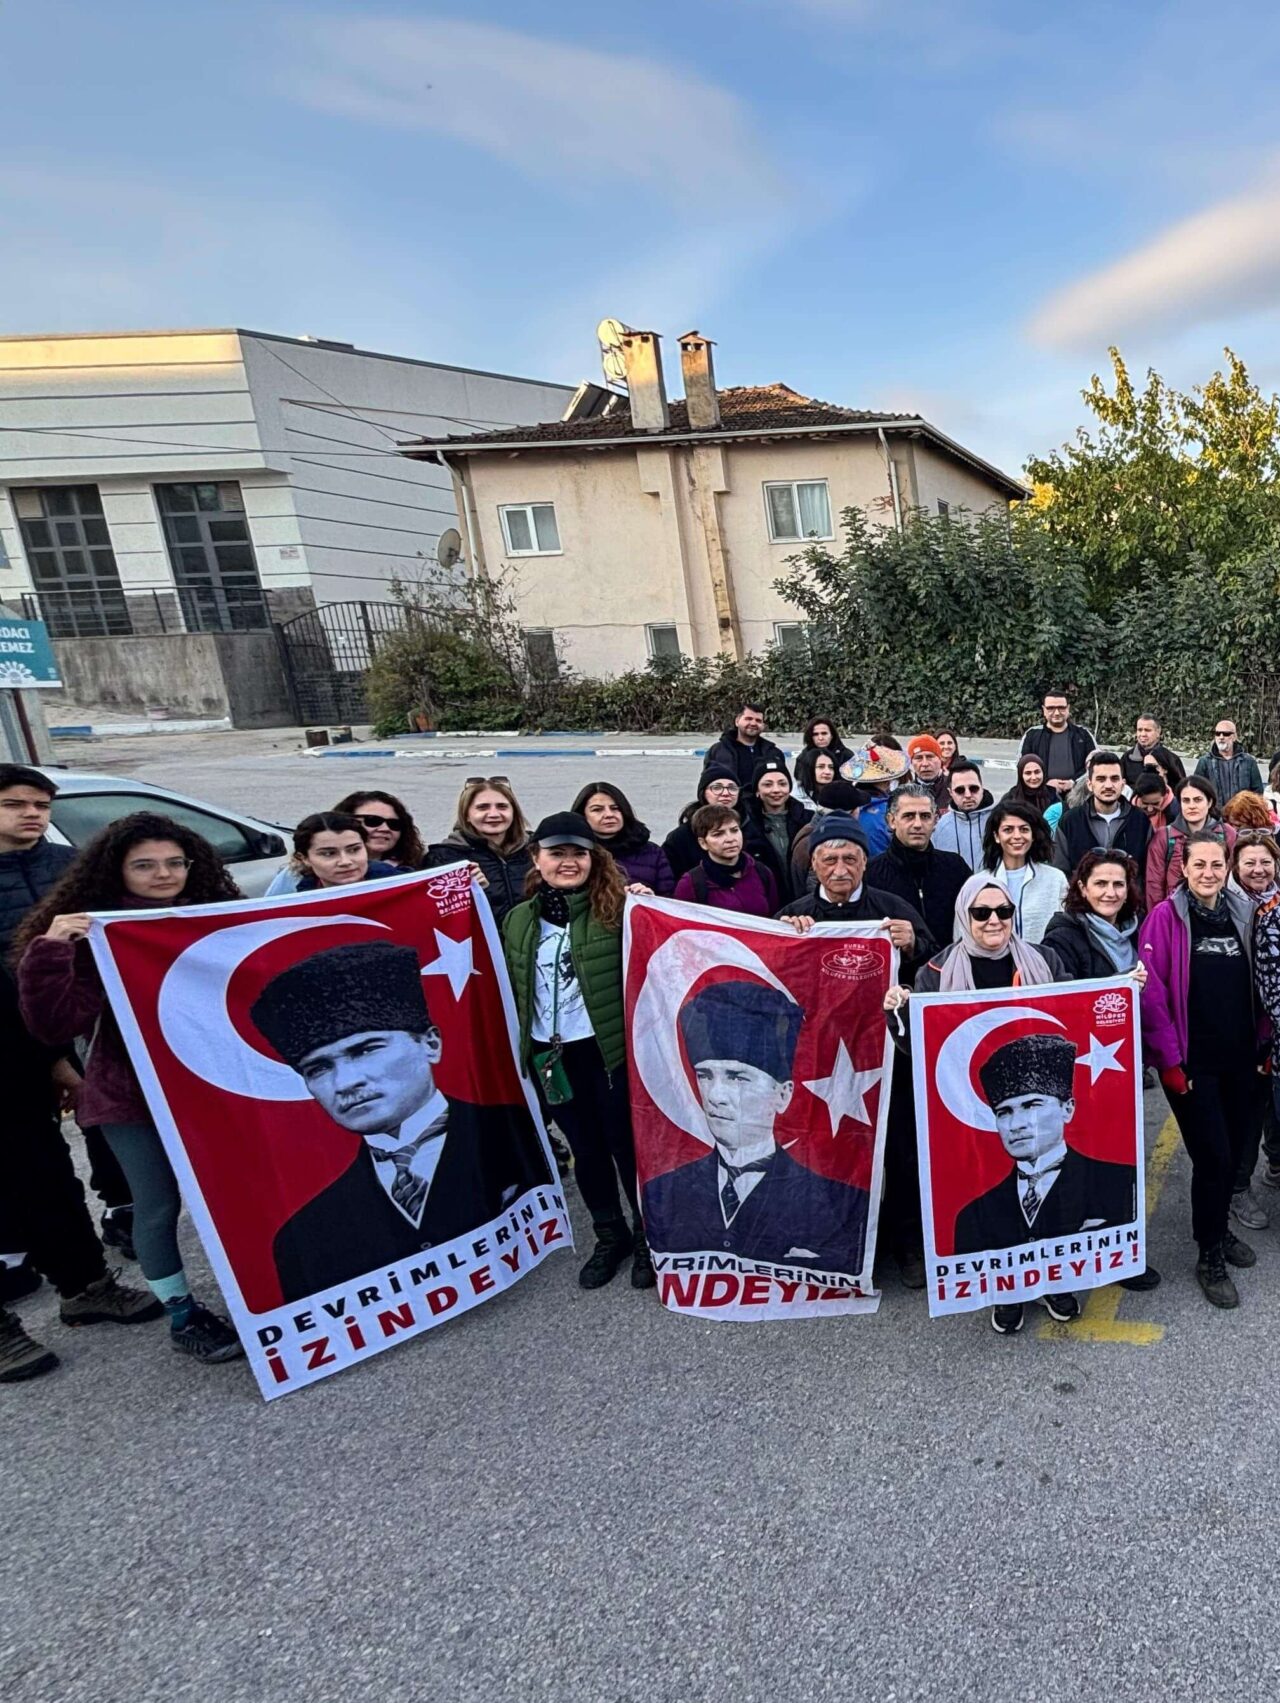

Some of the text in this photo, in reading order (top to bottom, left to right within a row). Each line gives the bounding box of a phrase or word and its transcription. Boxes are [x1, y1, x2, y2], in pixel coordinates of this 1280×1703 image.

[0, 641, 35, 654] EMEZ
[256, 1191, 565, 1348] DEVRİMLERİNİN
[936, 1229, 1139, 1277] DEVRİMLERİNİN
